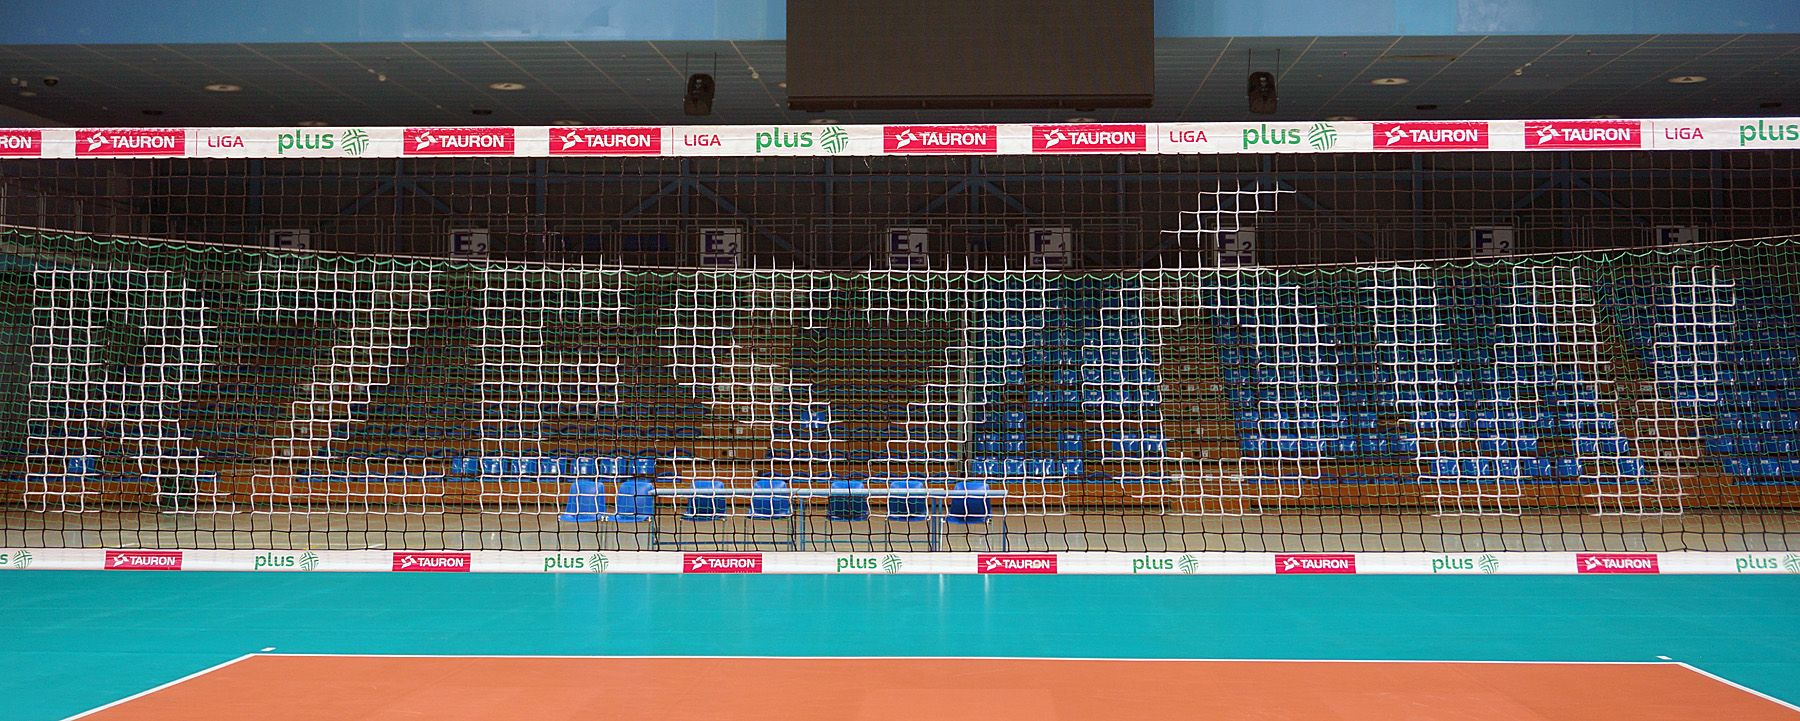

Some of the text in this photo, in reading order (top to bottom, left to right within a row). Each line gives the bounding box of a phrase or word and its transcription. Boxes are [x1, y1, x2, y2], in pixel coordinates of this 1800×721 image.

[684, 127, 812, 153] LIGA plus
[919, 132, 987, 146] TAURON
[1068, 131, 1136, 145] TAURON
[1170, 124, 1300, 149] LIGA plus
[1409, 128, 1479, 143] TAURON
[1561, 127, 1631, 142] TAURON
[1665, 120, 1799, 146] LIGA plus
[110, 136, 175, 149] TAURON
[208, 129, 334, 155] LIGA plus
[439, 135, 505, 148] TAURON
[586, 135, 651, 148] TAURON
[129, 556, 176, 566] TAURON
[254, 552, 294, 570] plus
[418, 557, 464, 568] TAURON
[544, 554, 584, 572] plus
[708, 558, 755, 568] TAURON
[837, 555, 877, 572] plus
[1003, 559, 1050, 569] TAURON
[1133, 555, 1174, 573] plus
[1299, 559, 1349, 569] TAURON
[1432, 555, 1474, 573] plus
[1602, 558, 1652, 569] TAURON
[1736, 554, 1778, 573] plus
